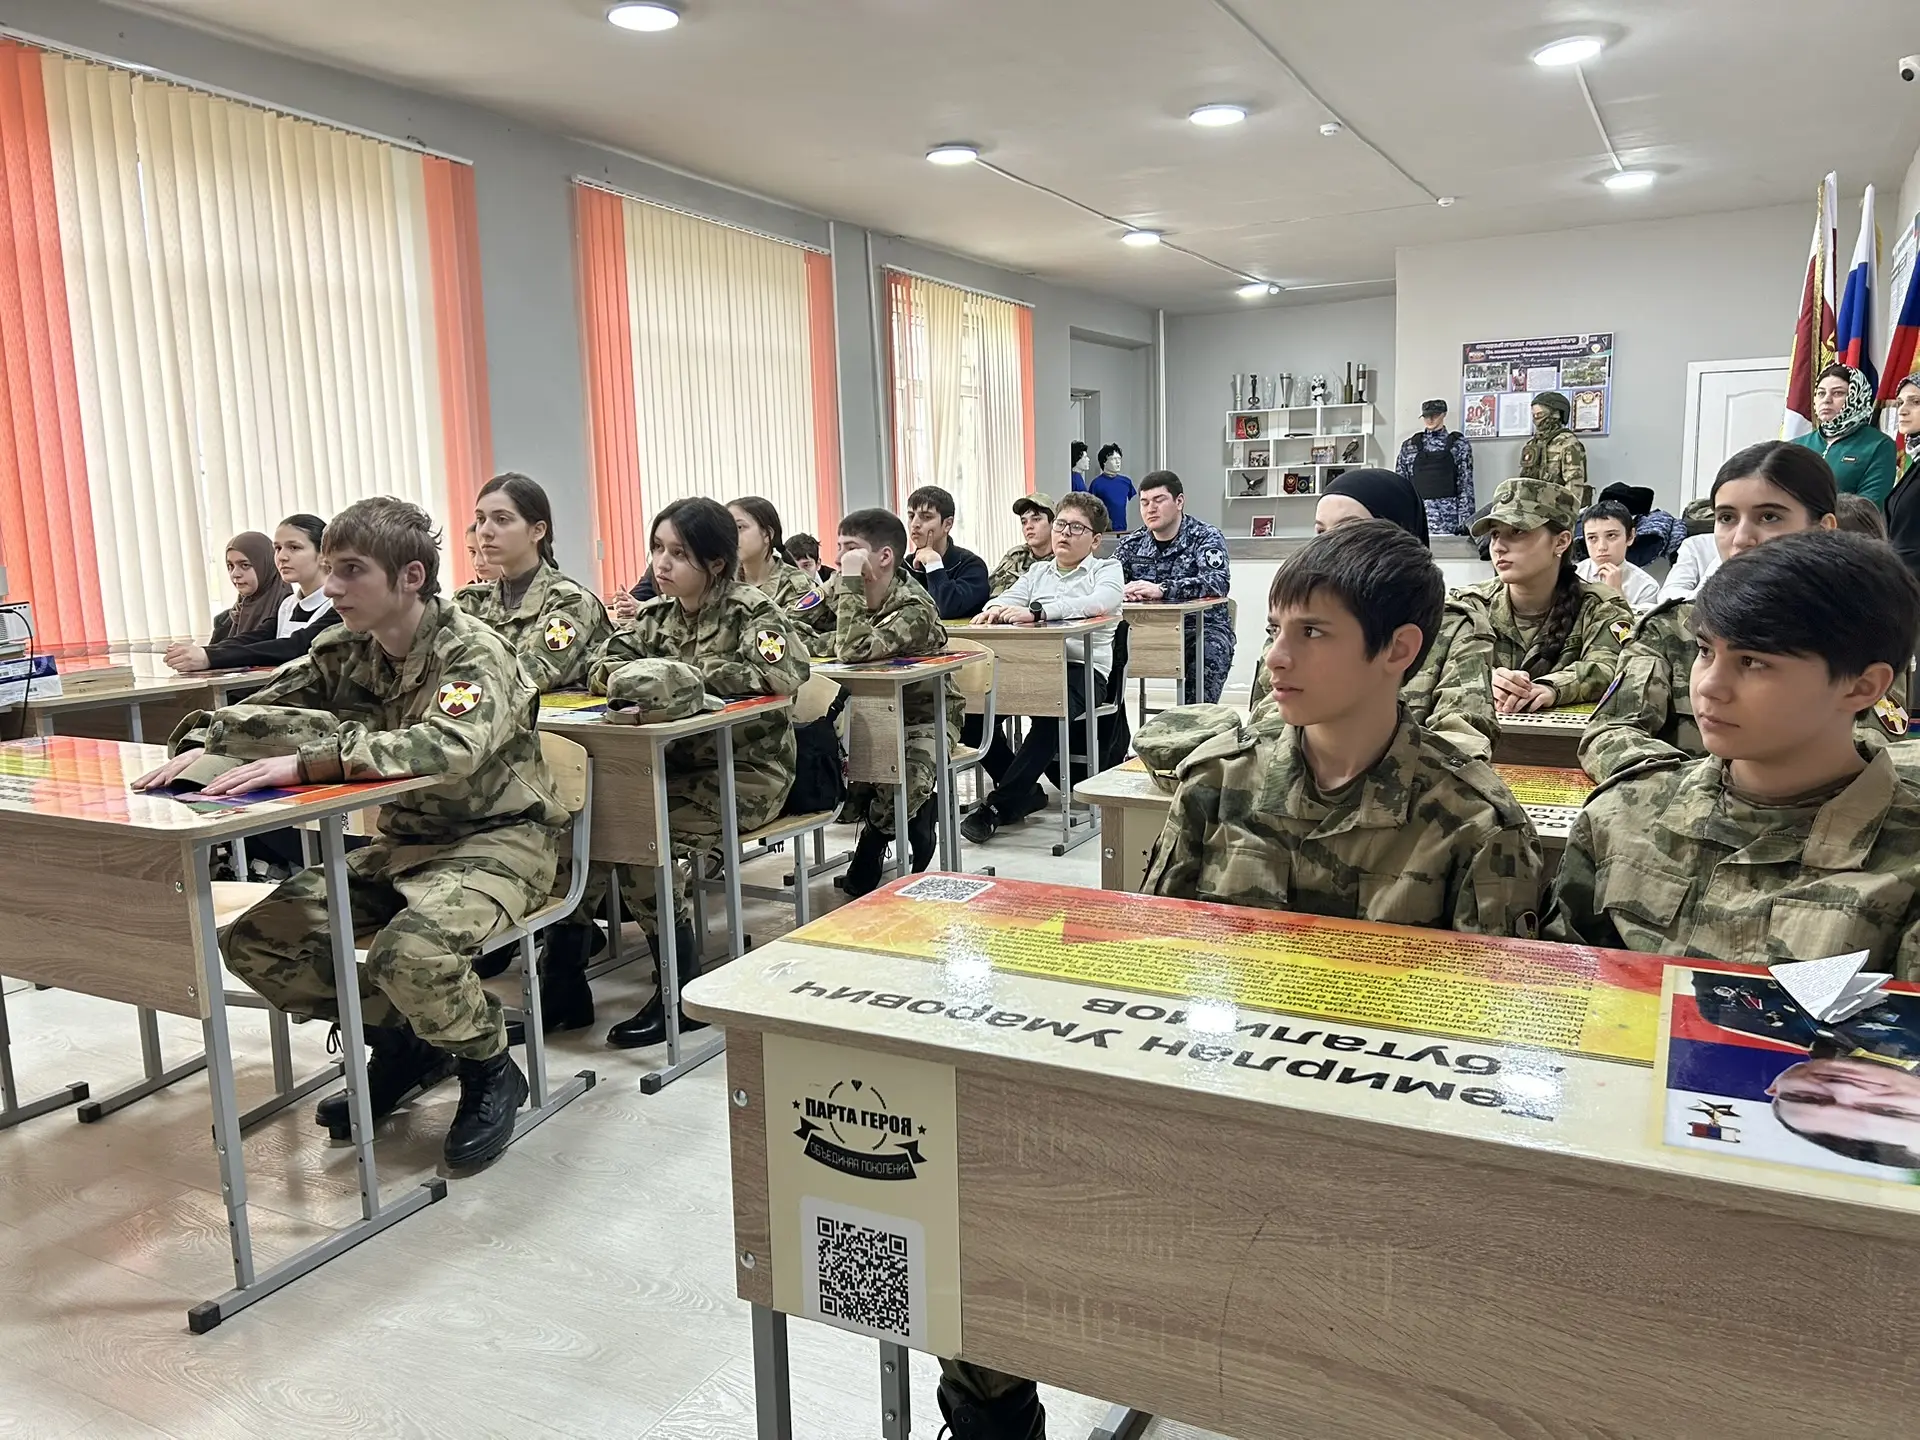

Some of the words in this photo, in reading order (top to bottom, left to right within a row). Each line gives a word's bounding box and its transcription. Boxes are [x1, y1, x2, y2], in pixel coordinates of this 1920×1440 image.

[1467, 405, 1483, 422] 80
[788, 979, 1123, 1050] Умарович
[805, 1097, 858, 1126] ПАРТА
[861, 1110, 912, 1137] ГЕРОЯ
[810, 1141, 860, 1171] ОБЪЕДИНЯЯ
[861, 1159, 910, 1175] ПОКОЛЕНИЯ
